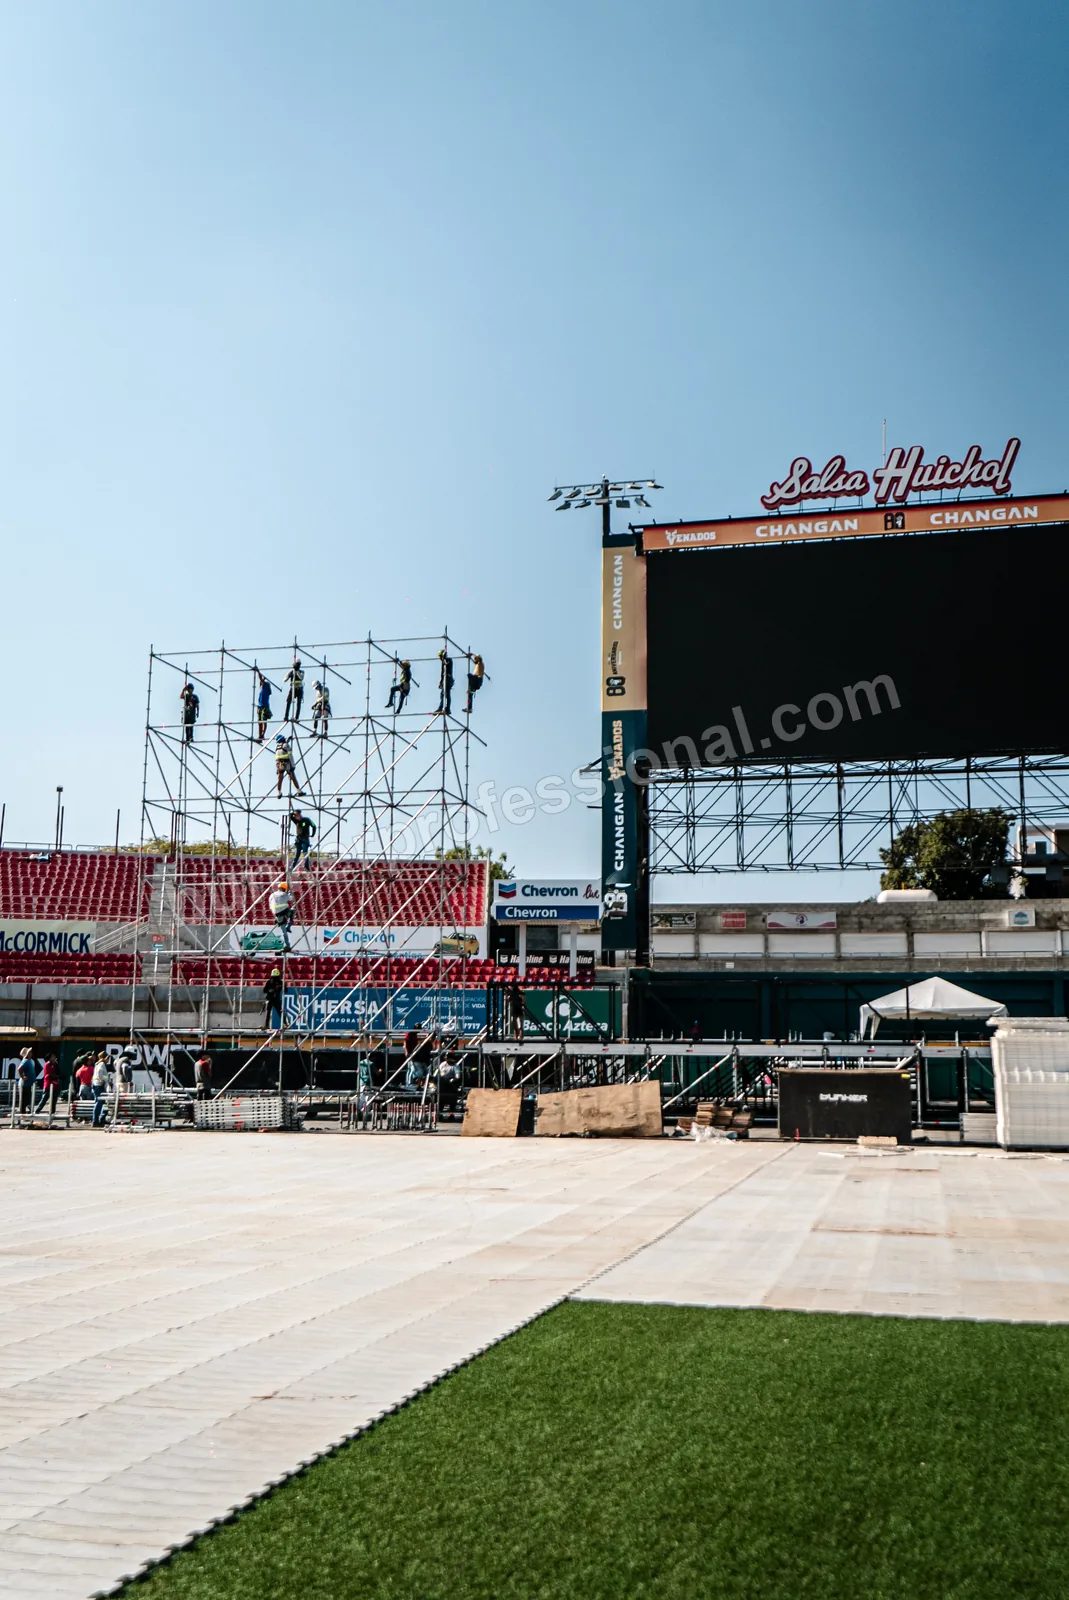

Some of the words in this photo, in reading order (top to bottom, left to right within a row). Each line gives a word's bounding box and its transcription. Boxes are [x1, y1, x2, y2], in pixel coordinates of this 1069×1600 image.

[761, 455, 869, 510] Salsa
[873, 437, 1021, 503] Huichol
[755, 518, 858, 538] CHANGAN
[930, 505, 1039, 526] CHANGAN
[666, 530, 716, 546] VENADOS
[612, 554, 623, 630] CHANGAN
[608, 720, 626, 781] VENADOS
[613, 792, 624, 871] CHANGAN
[521, 884, 579, 897] Chevron
[504, 906, 558, 918] Chevron
[344, 930, 395, 943] Chevron
[313, 999, 380, 1014] HERSA
